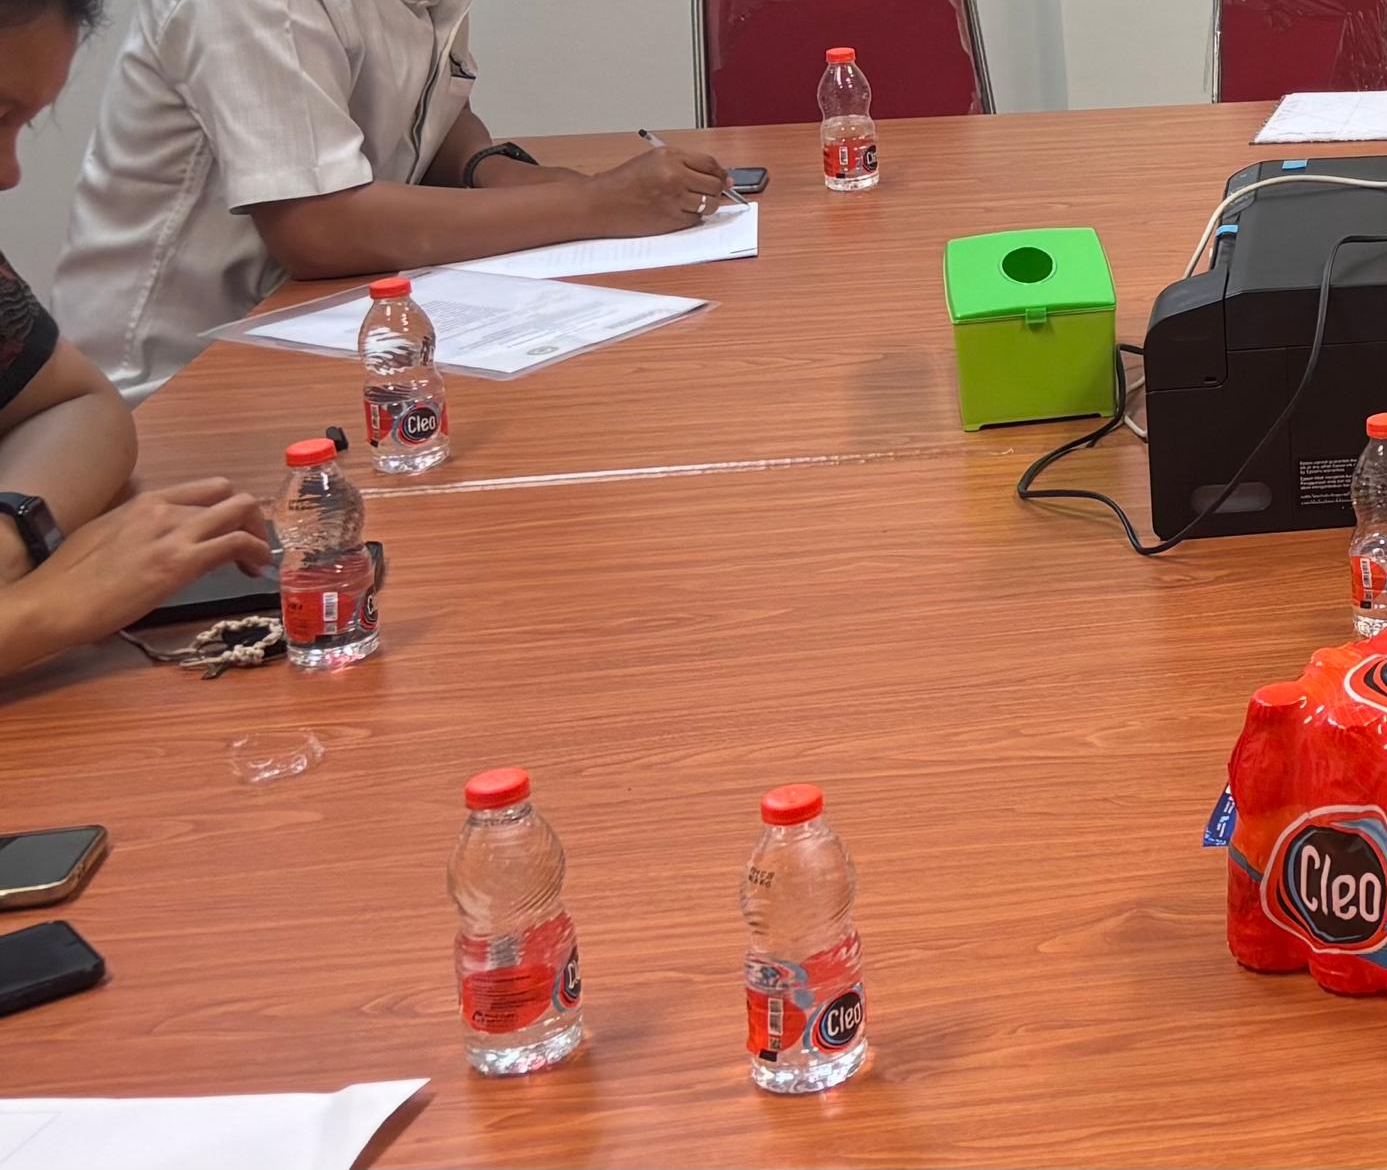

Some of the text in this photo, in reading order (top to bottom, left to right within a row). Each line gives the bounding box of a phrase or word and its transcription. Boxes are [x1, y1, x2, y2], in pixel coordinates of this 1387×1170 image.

[408, 416, 435, 433] Cleo
[1298, 843, 1384, 922] Cleo
[826, 1002, 863, 1037] Cleo
